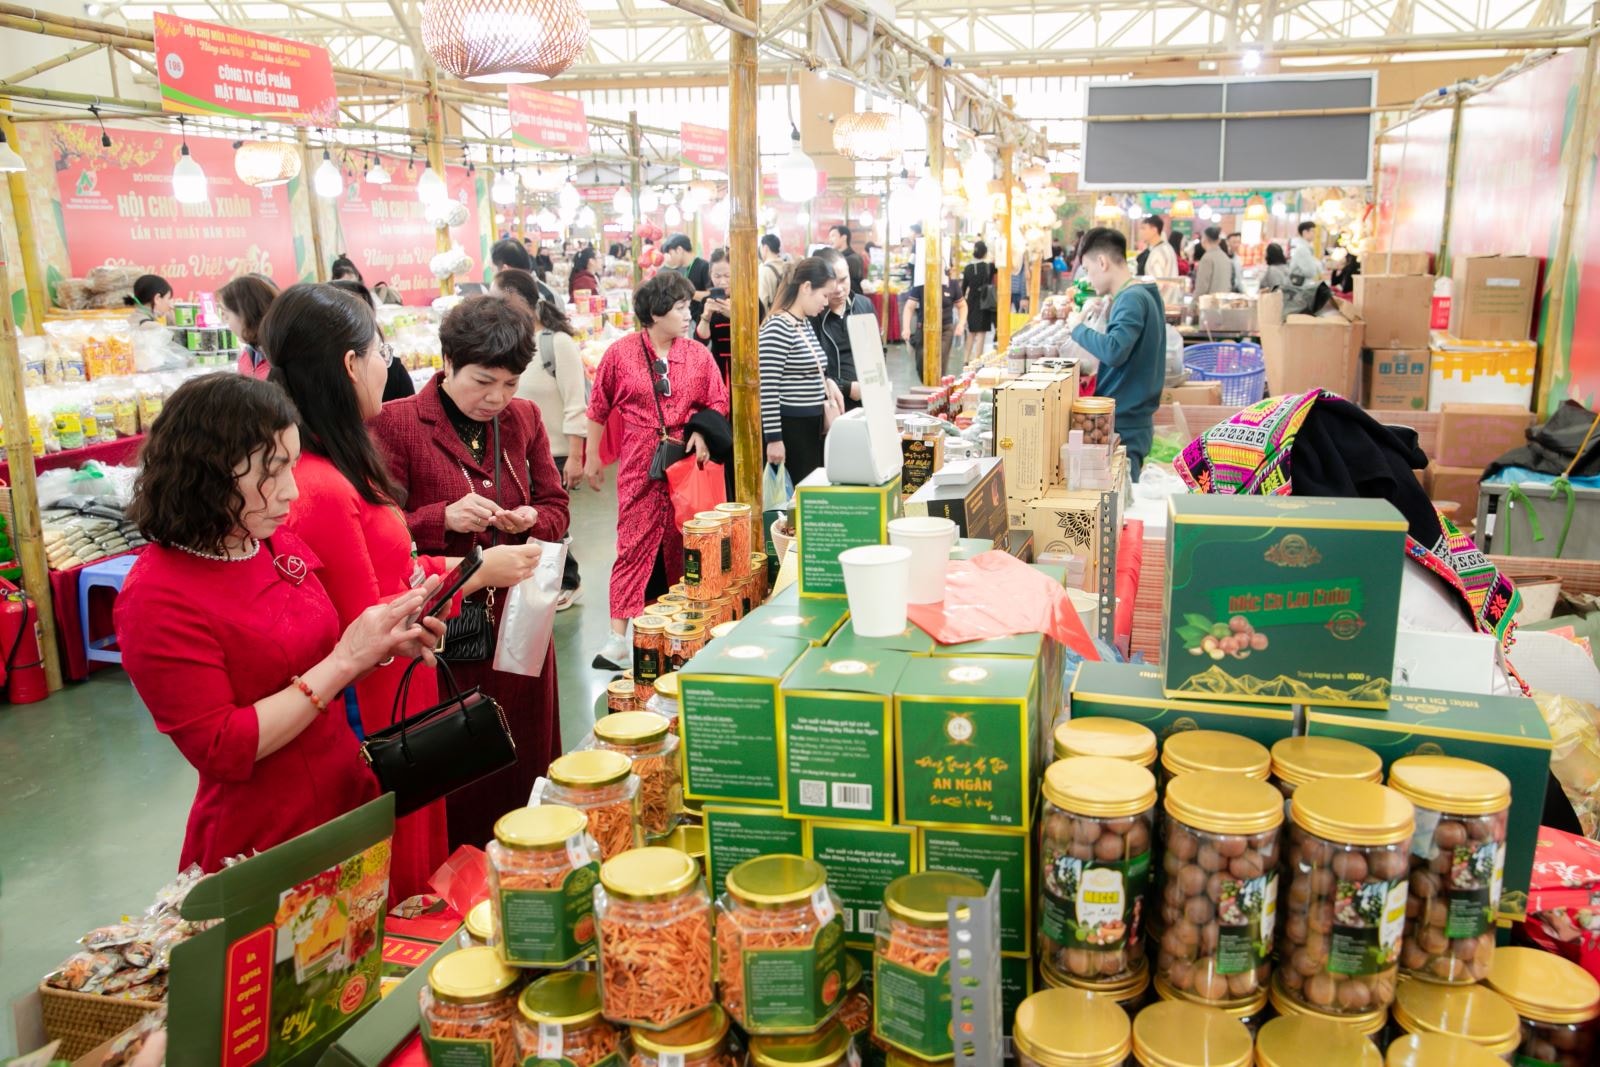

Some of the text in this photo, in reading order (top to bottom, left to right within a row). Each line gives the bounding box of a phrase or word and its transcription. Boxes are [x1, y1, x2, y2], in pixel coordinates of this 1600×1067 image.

[218, 64, 291, 89] CÔNG TY CỔ PHẦN
[214, 84, 234, 102] MẬT
[276, 92, 299, 108] XANH
[117, 191, 146, 221] HỘI
[150, 194, 178, 222] CHỢ
[217, 193, 252, 218] XUÂN
[189, 254, 225, 279] Việt
[1347, 672, 1365, 681] 1000
[933, 776, 993, 792] AN NGÂN
